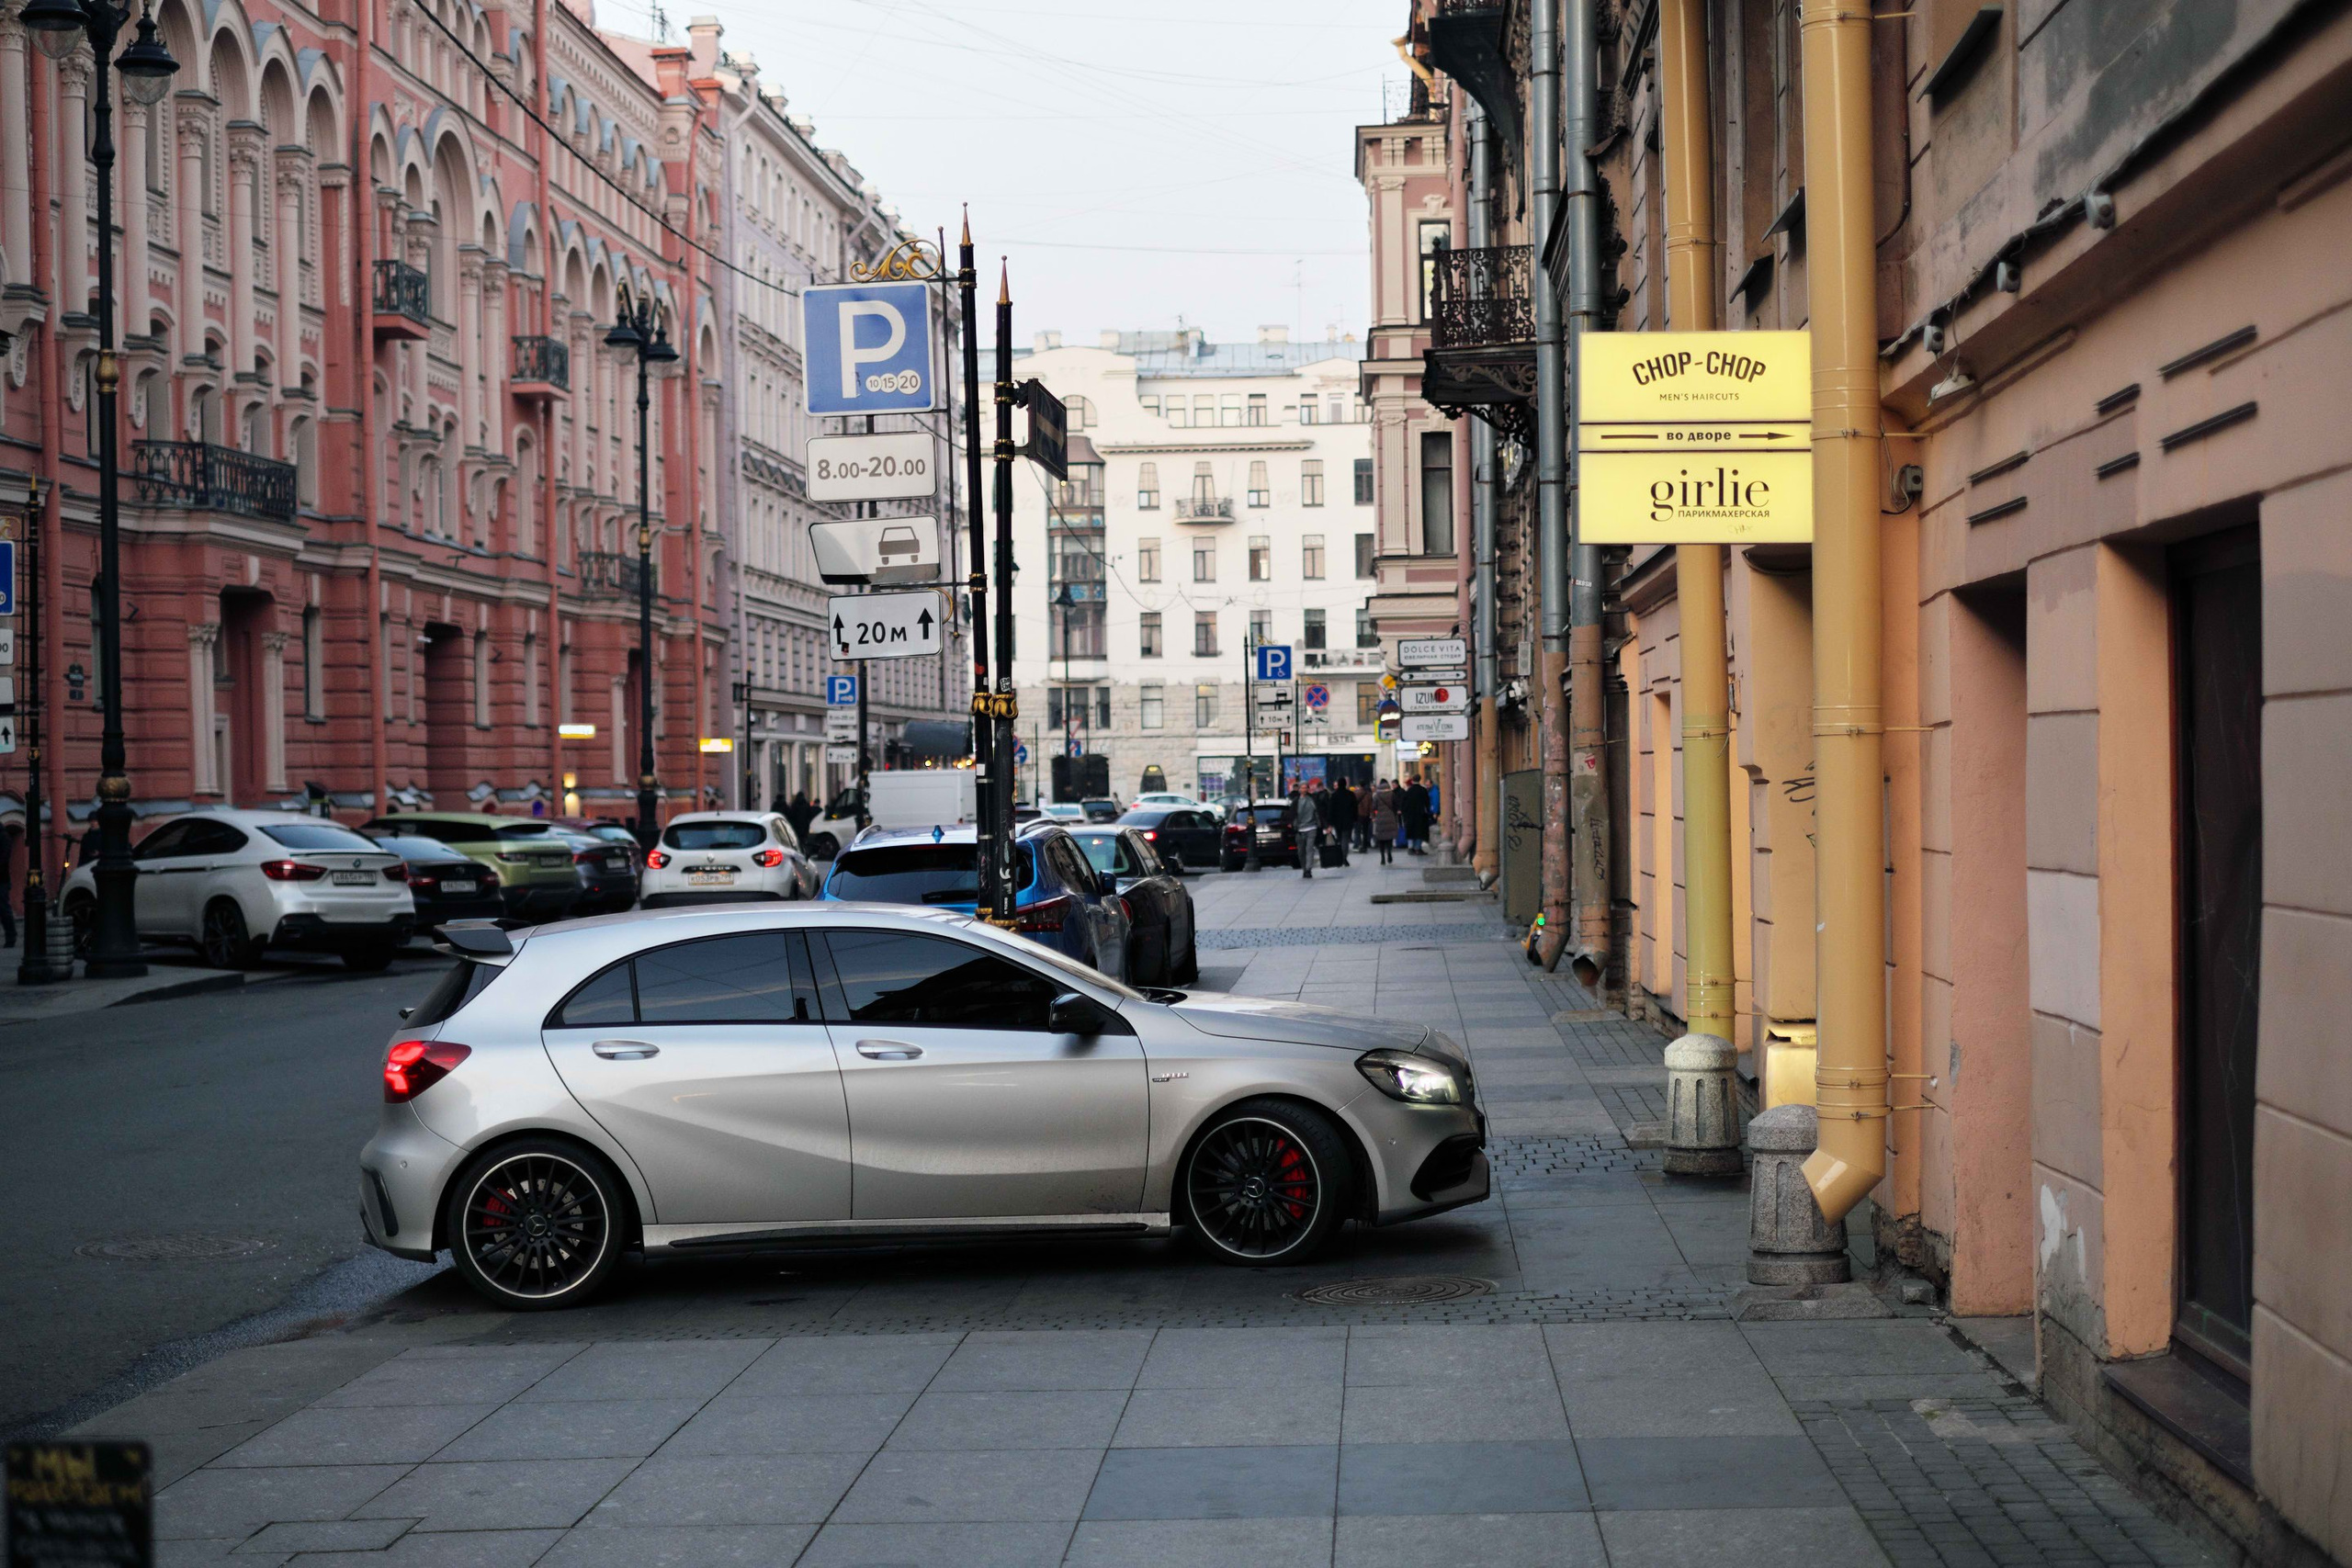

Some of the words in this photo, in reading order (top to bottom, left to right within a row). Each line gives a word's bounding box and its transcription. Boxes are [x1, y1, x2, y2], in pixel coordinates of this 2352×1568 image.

[838, 299, 906, 399] P
[1632, 351, 1767, 386] CHOP-CHOP
[899, 375, 919, 389] 20
[1659, 393, 1690, 401] MEN'S
[1691, 392, 1740, 401] HAIRCUTS
[1667, 432, 1684, 440] во
[1687, 432, 1732, 442] дворе
[817, 456, 926, 480] 8.00-20.00
[1650, 467, 1770, 522] girlie
[1678, 510, 1770, 518] ПАРИКМАХЕРСКАЯ
[1404, 645, 1435, 654] DOLCE
[1266, 649, 1286, 677] P
[834, 678, 852, 703] P
[1328, 735, 1356, 743] ESTEL
